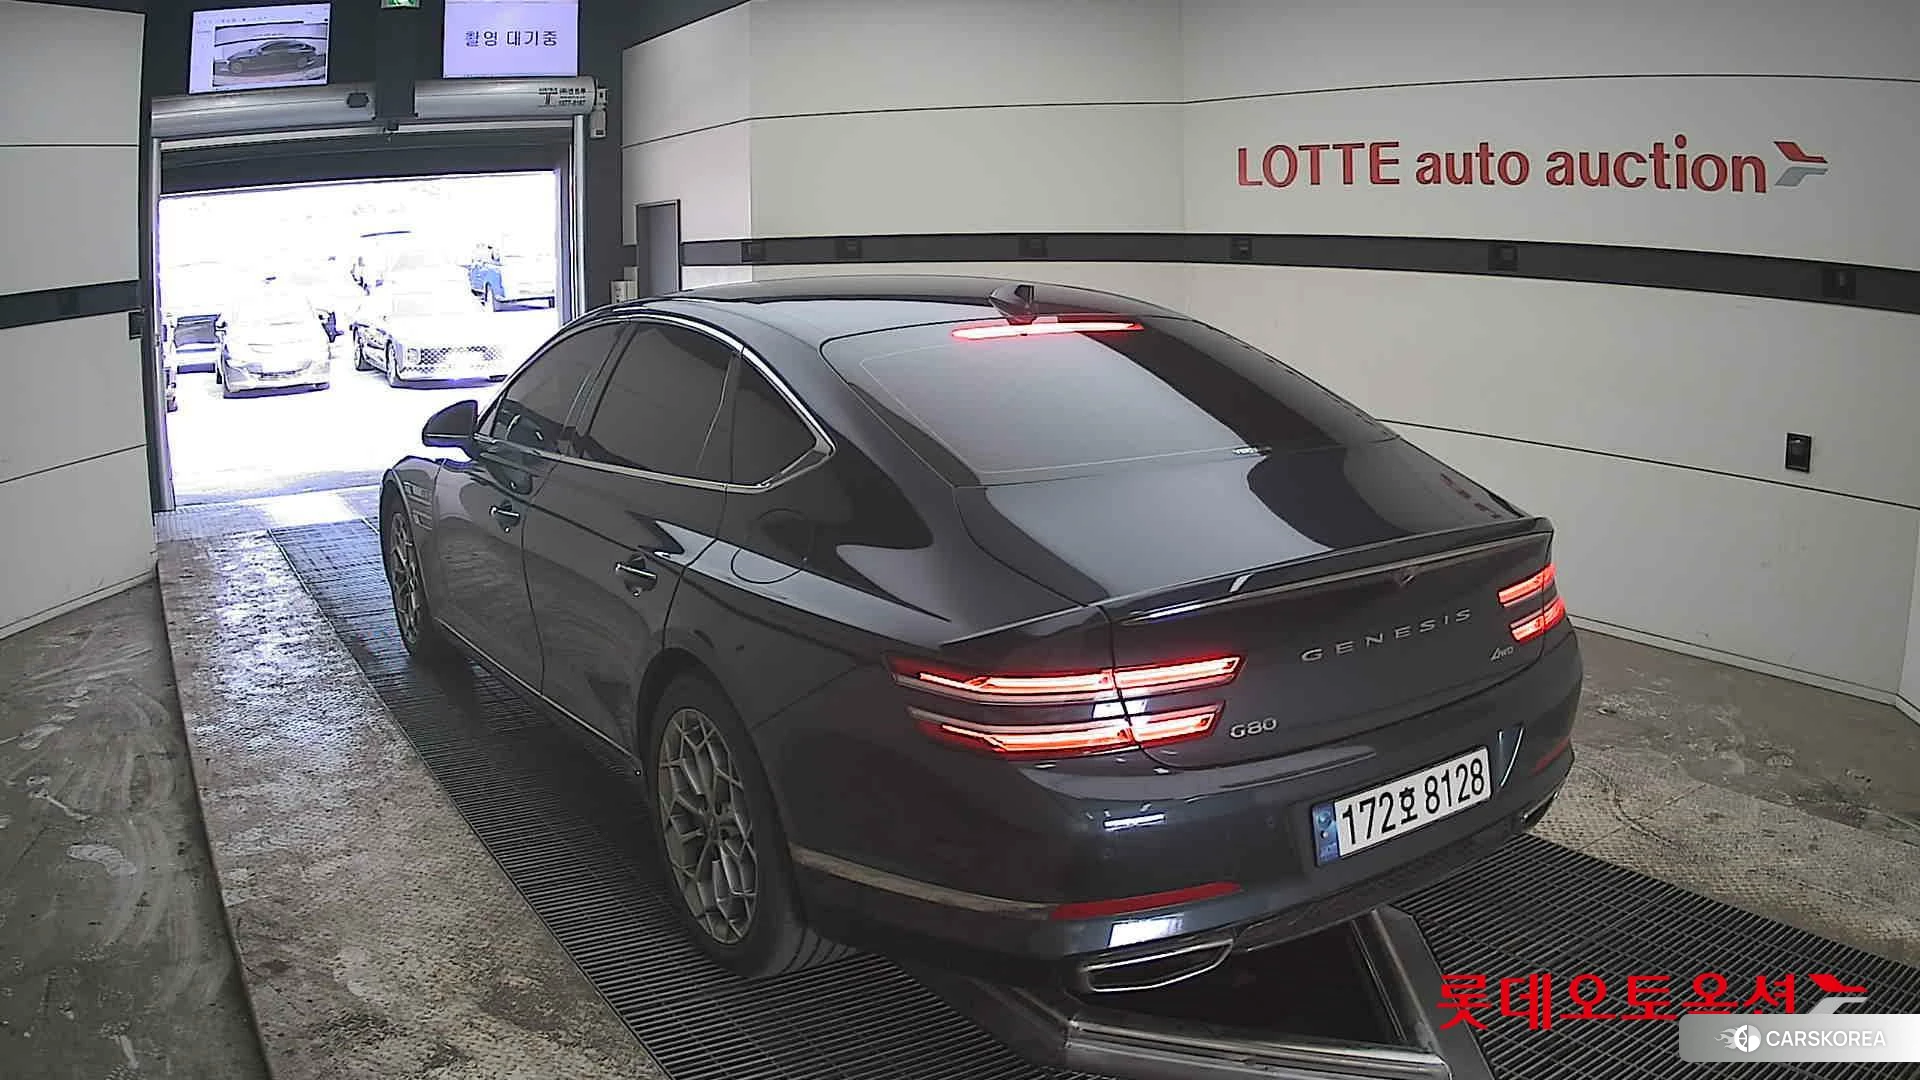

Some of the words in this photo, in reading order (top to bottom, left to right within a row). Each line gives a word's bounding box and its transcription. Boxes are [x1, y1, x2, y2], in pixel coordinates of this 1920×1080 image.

[506, 30, 557, 47] 대기중
[1237, 141, 1400, 188] LOTTE
[1415, 142, 1530, 186] auto
[1545, 134, 1767, 193] auction
[1300, 608, 1471, 662] GENESIS
[1229, 717, 1278, 738] G80
[1342, 787, 1418, 845] 172호
[1424, 757, 1485, 814] 8128
